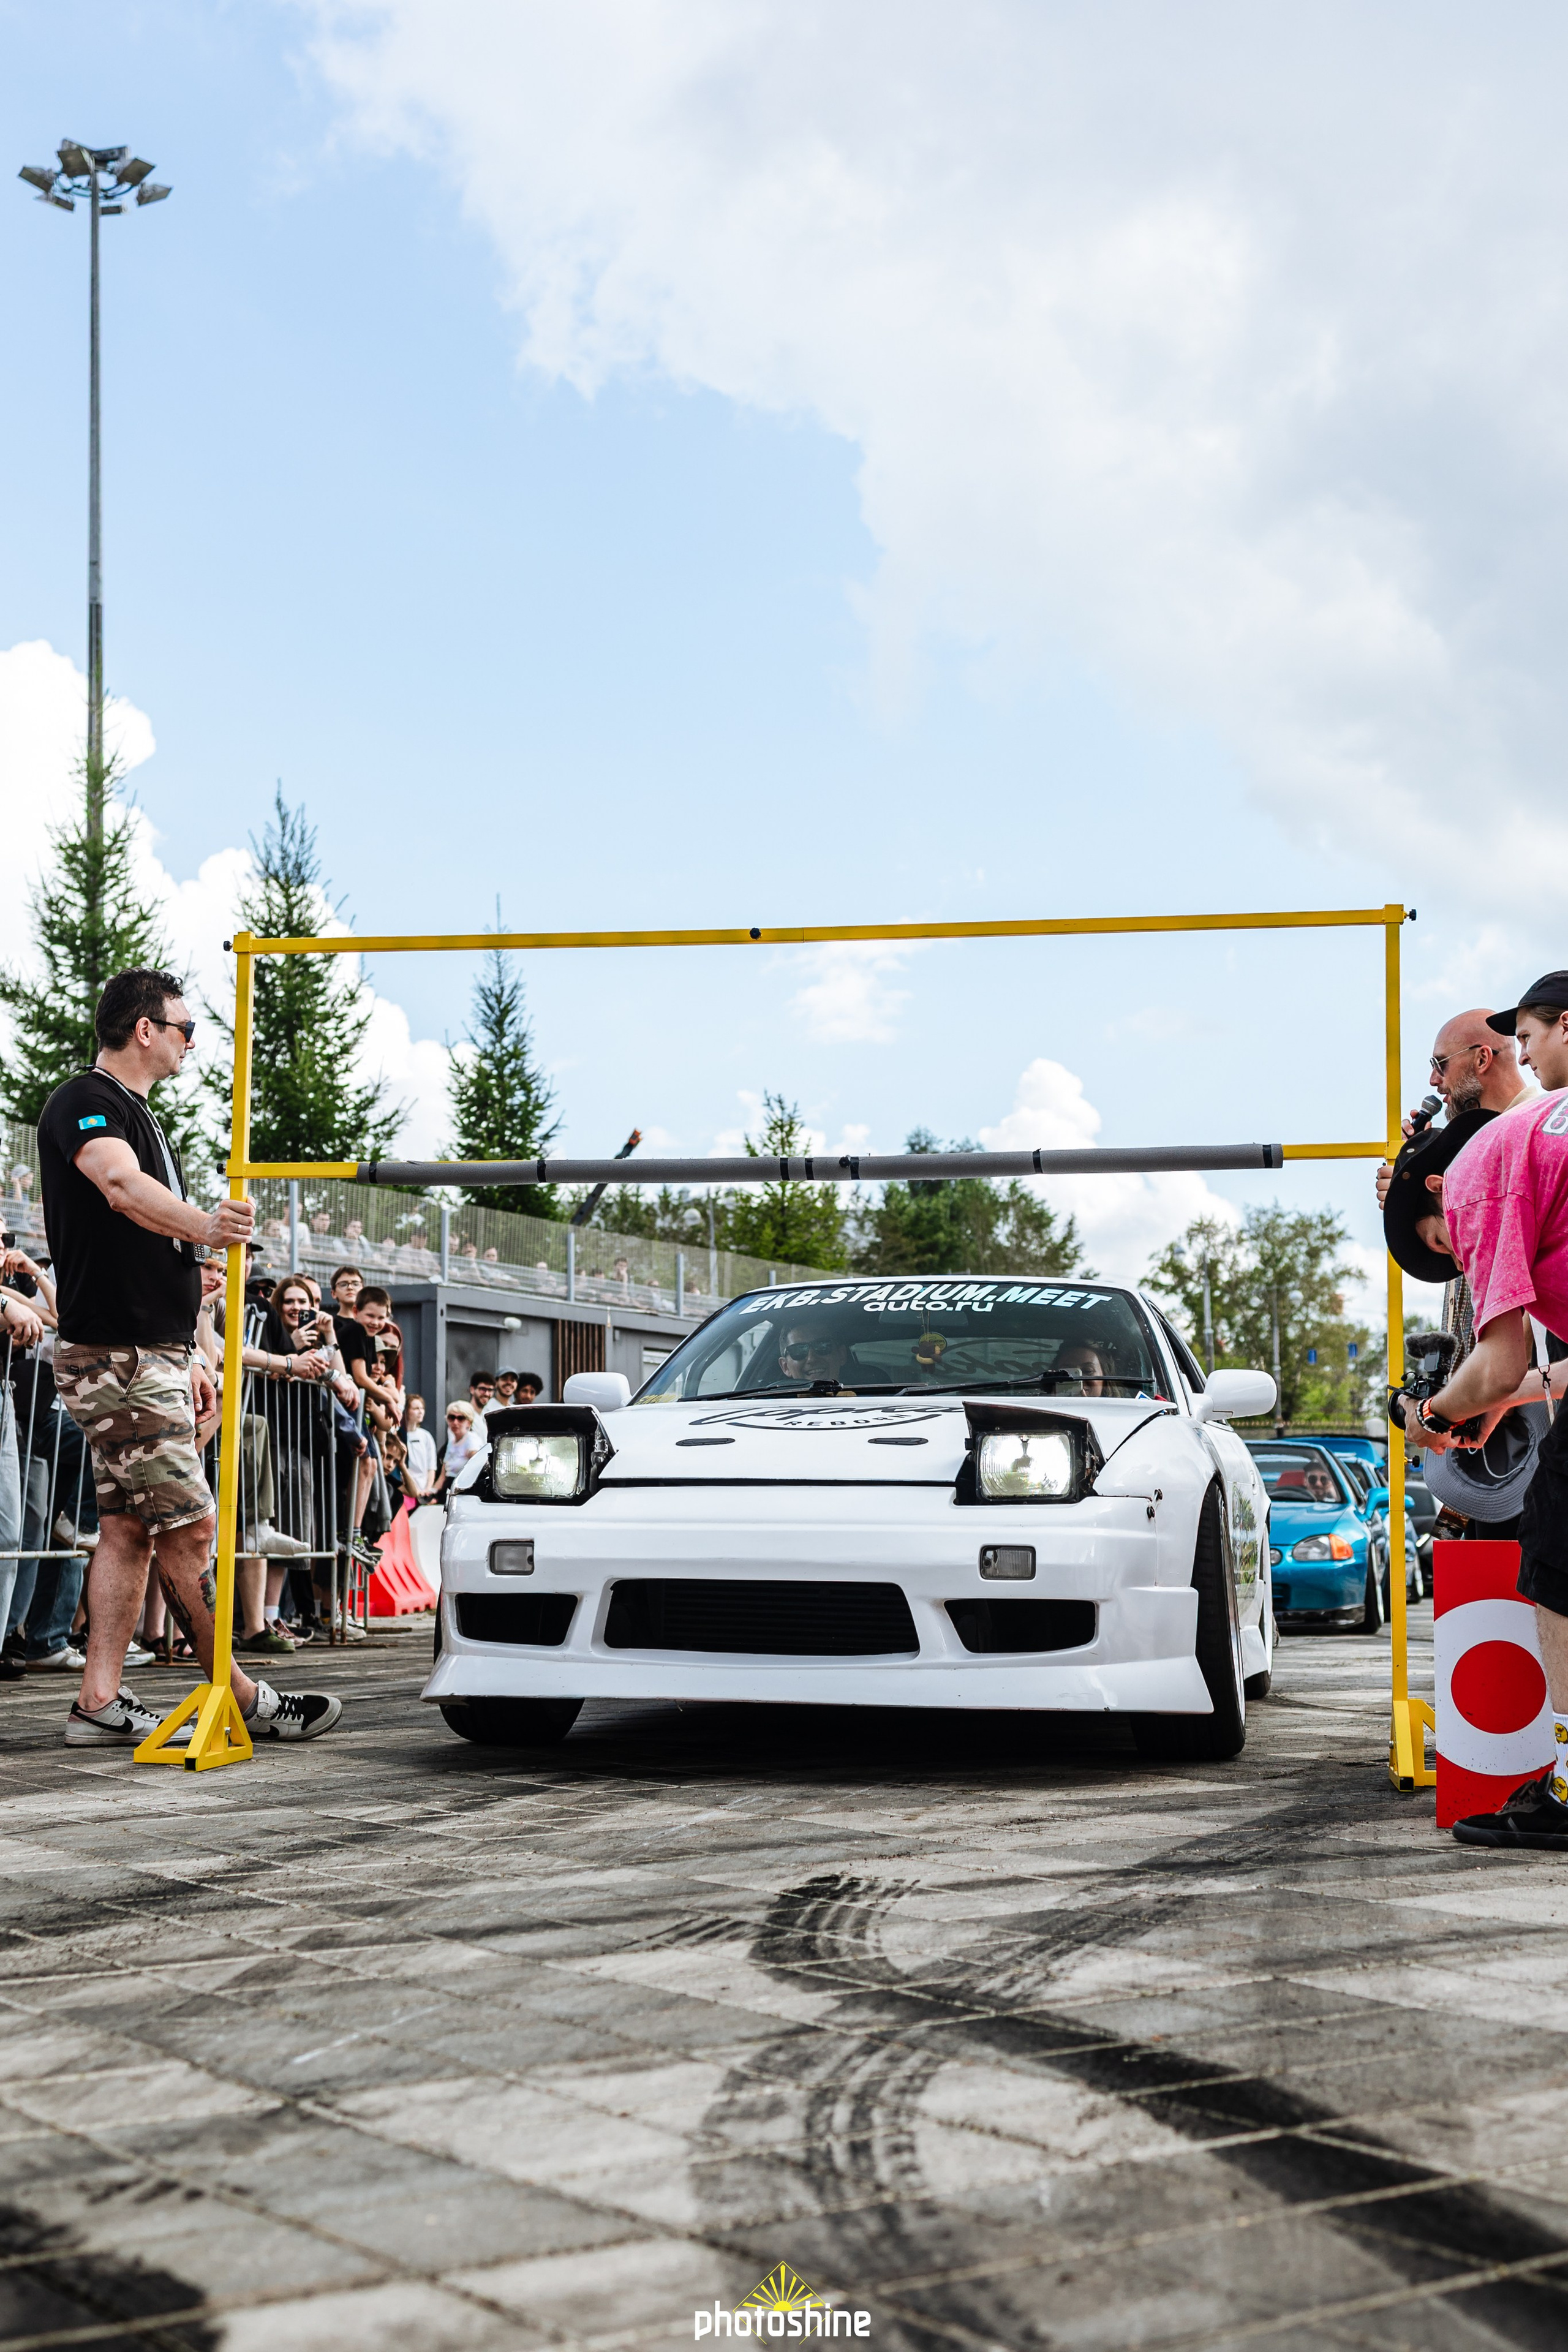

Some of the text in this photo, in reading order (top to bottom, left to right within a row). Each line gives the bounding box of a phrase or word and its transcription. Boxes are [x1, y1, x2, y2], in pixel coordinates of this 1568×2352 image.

[739, 1284, 1112, 1315] EKB.STADIUM.MEET
[863, 1299, 994, 1312] auto.ru
[783, 1414, 911, 1427] REBORN
